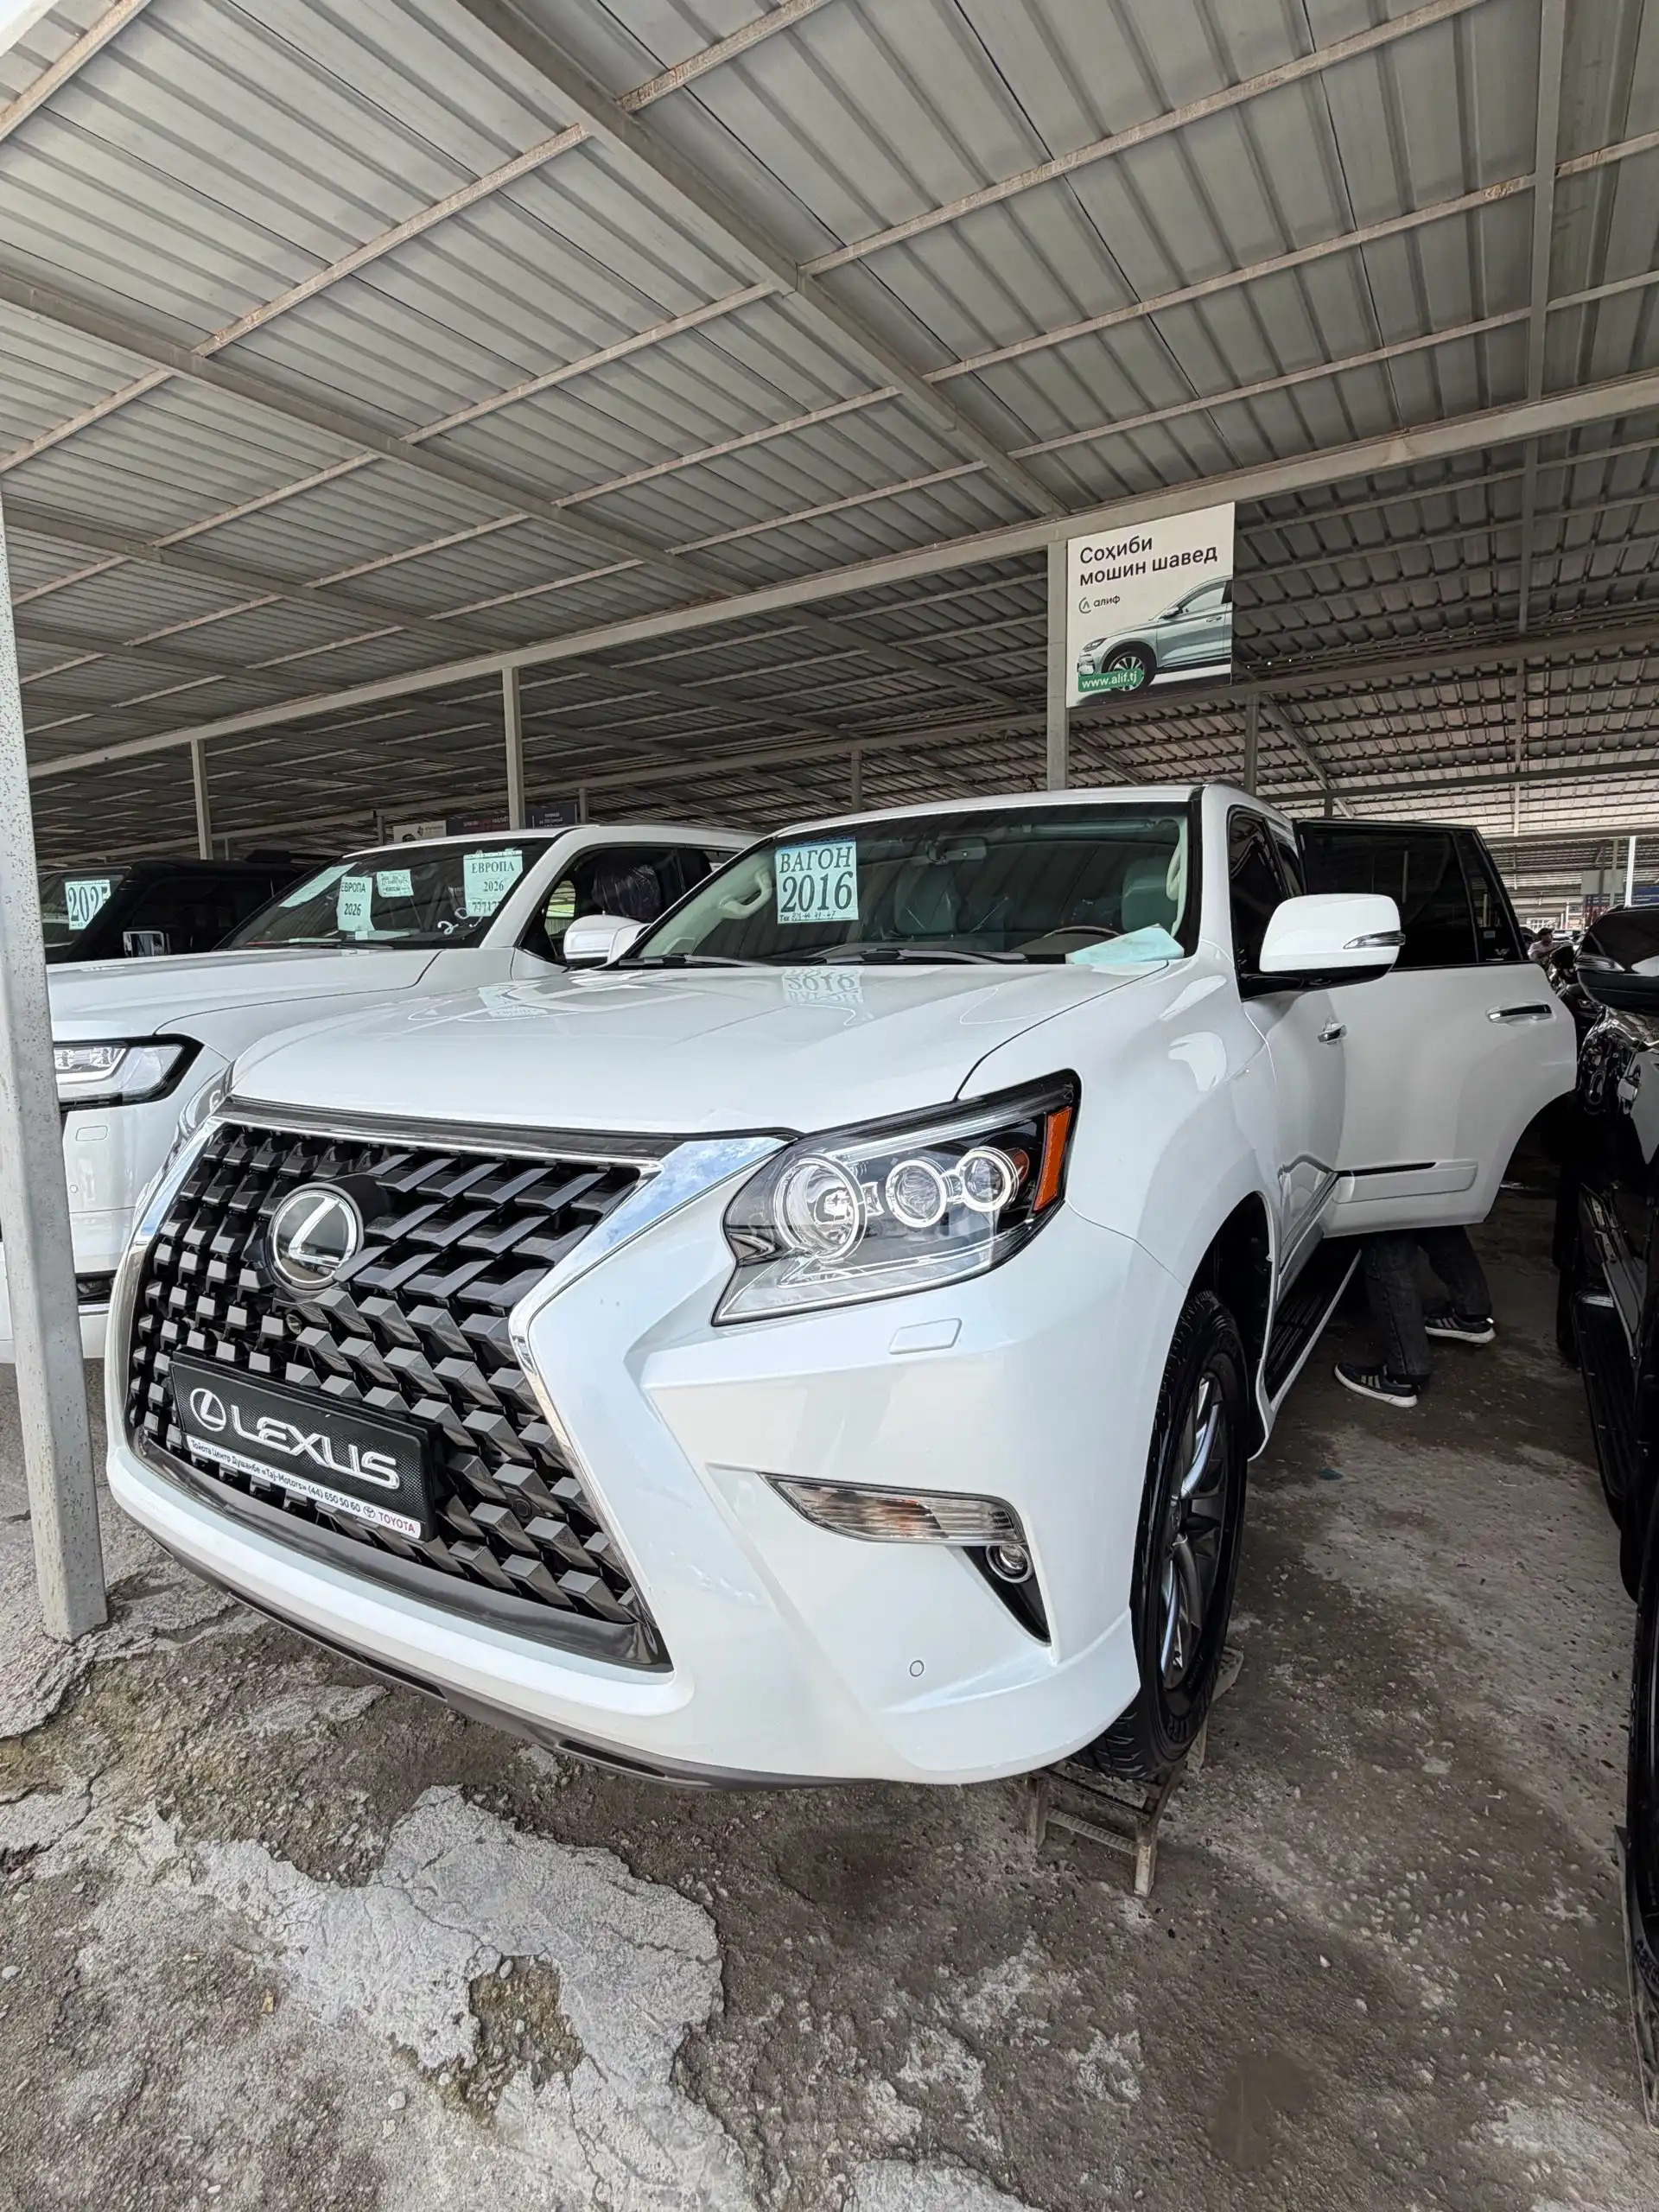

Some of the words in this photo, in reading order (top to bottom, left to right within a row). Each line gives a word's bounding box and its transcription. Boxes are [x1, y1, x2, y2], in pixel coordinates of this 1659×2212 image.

[1080, 535, 1153, 563] Соҳиби
[1080, 559, 1146, 586] мошин
[1152, 546, 1218, 572] шавед
[1093, 594, 1121, 607] алиф
[1082, 671, 1137, 689] www.alif.tj
[471, 861, 515, 874] ЕВРОПА
[779, 846, 853, 874] ВАГОН
[340, 881, 366, 893] ЕВРОПА
[483, 880, 504, 892] 2026
[780, 871, 854, 913] 2016
[344, 903, 362, 916] 2026
[231, 1404, 400, 1490] LEXUS
[308, 1485, 324, 1499] (44)
[324, 1491, 339, 1503] 650
[340, 1497, 349, 1509] 50
[350, 1503, 361, 1513] 60
[378, 1511, 416, 1534] TOYOTA
